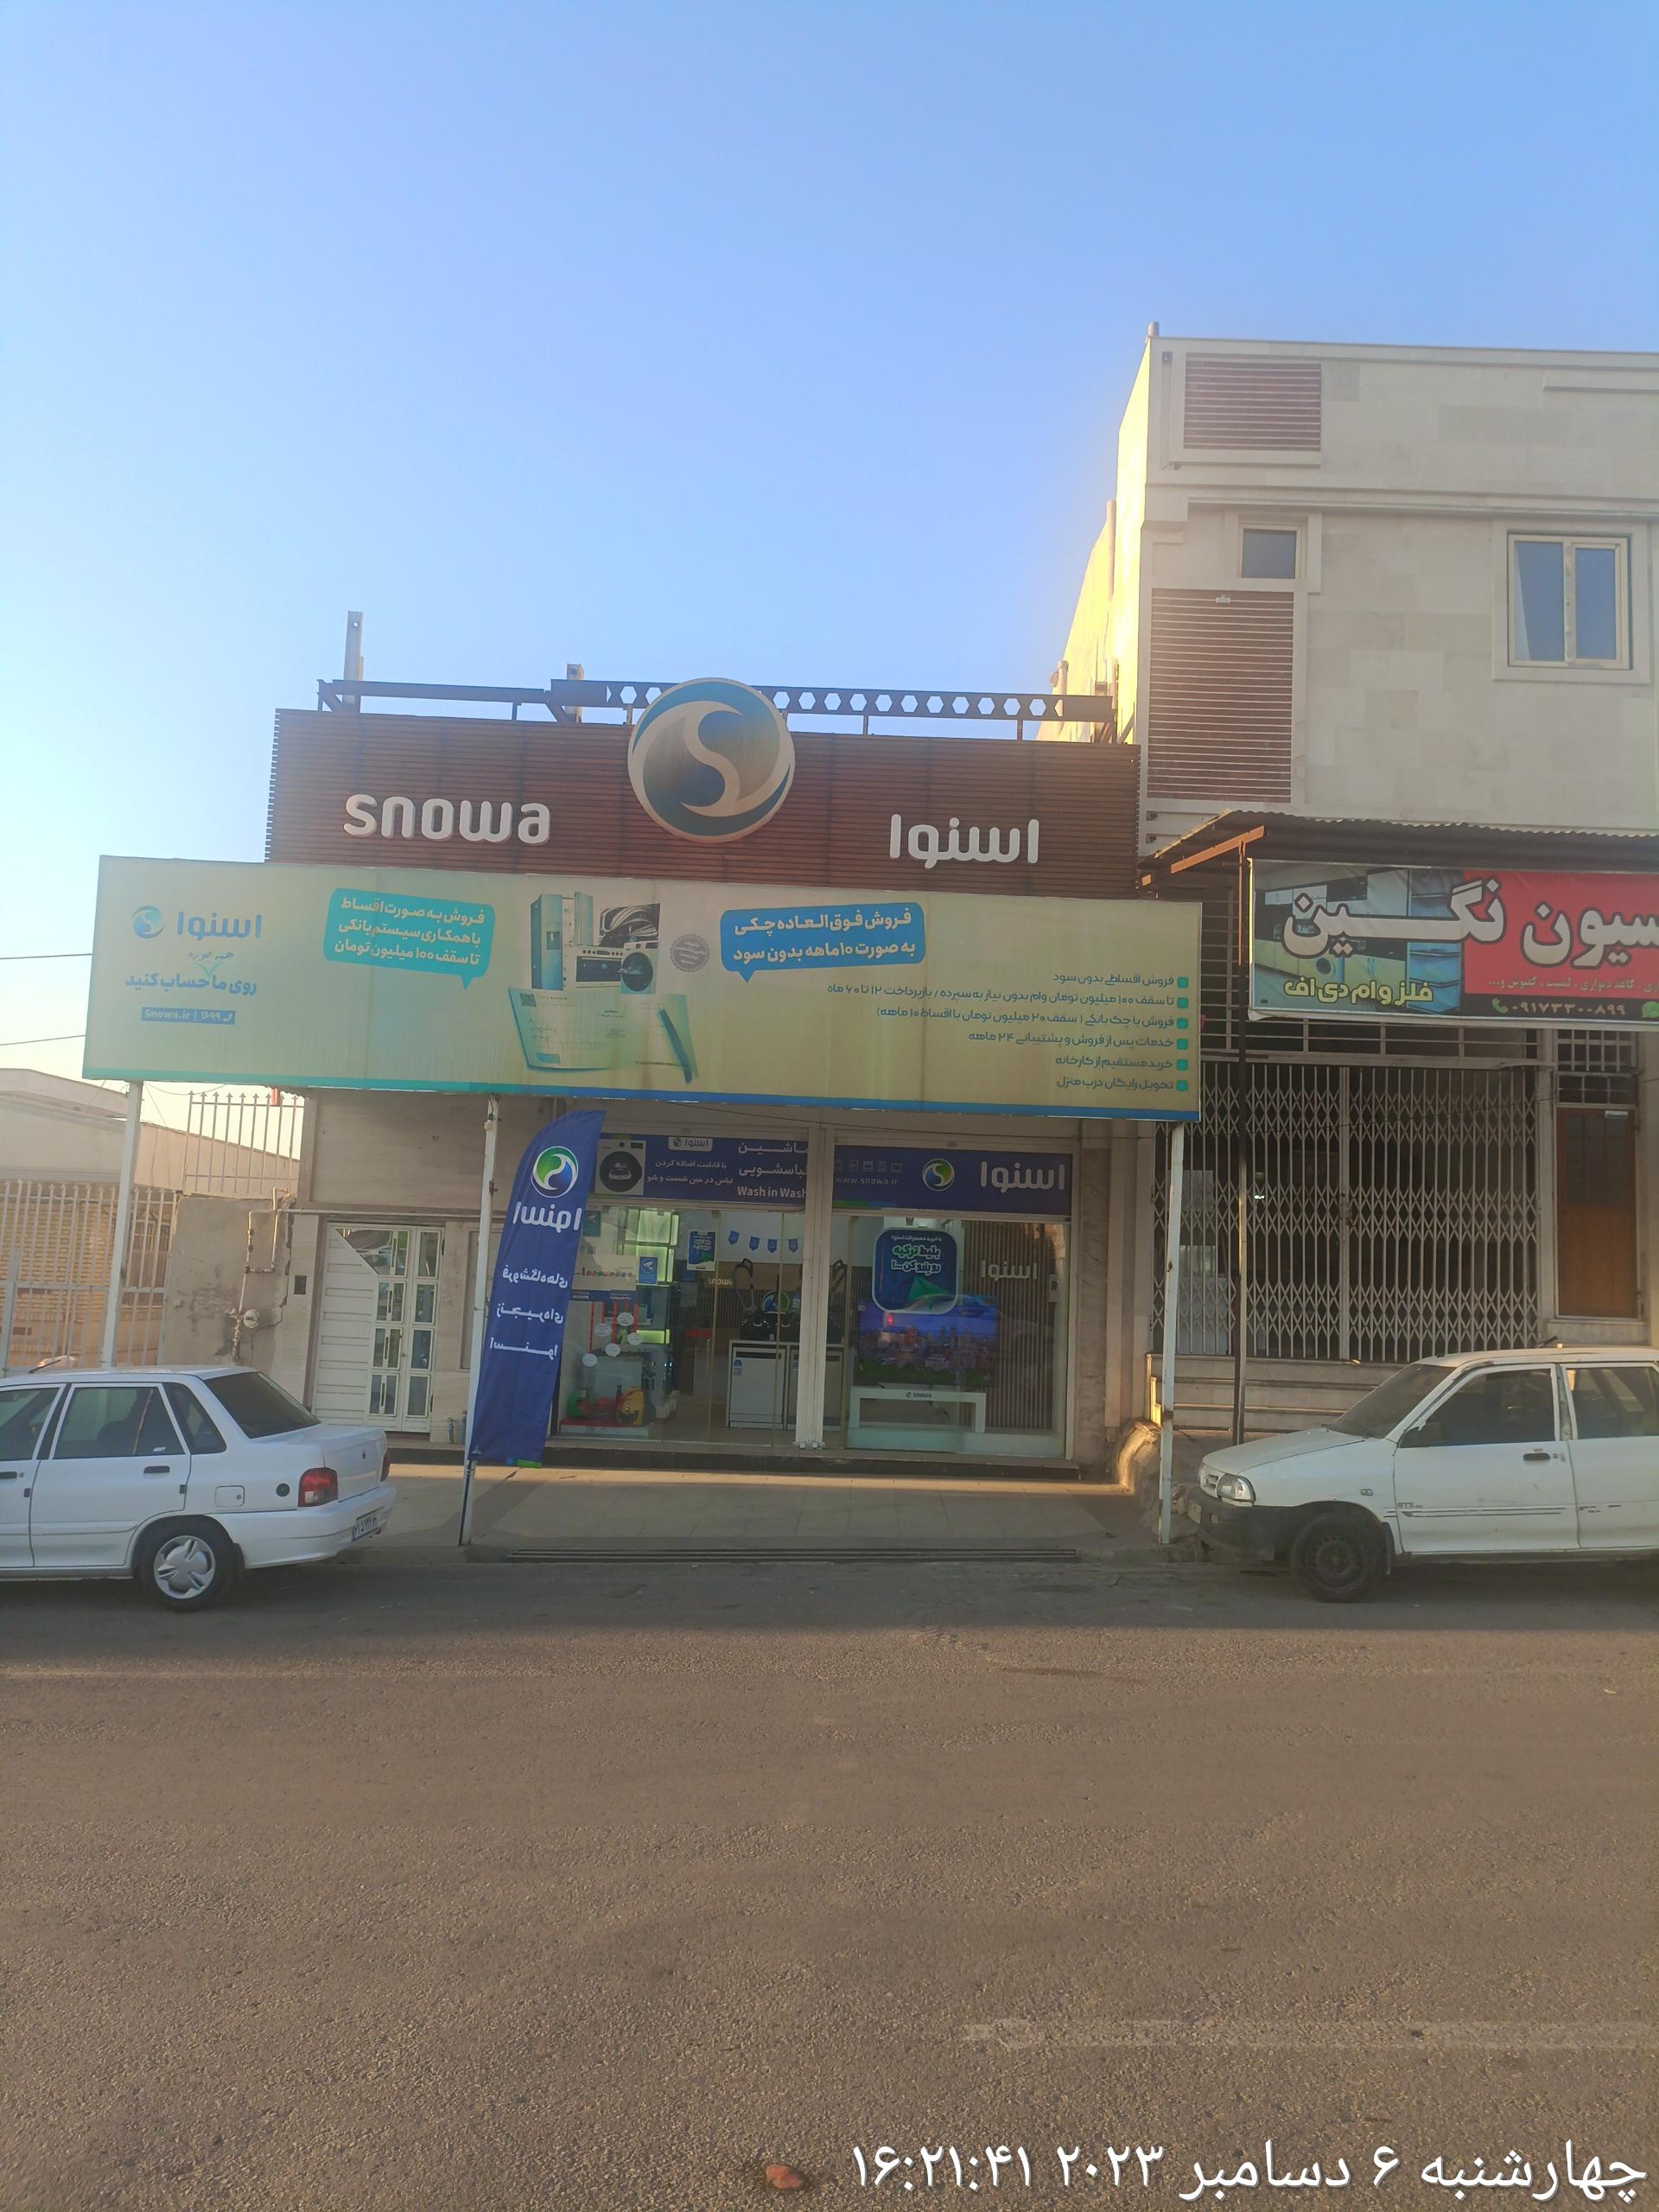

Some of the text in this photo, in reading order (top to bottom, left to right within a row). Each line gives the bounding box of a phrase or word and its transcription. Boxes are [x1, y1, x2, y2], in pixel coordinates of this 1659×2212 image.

[343, 791, 551, 844] snowa
[889, 814, 1039, 868] اسنوا
[340, 896, 486, 927] فروش به صورت اقساط
[1282, 878, 1506, 957] نگین
[176, 911, 263, 940] اسنوا
[734, 907, 912, 937] فروش فوق العاده چکی
[338, 918, 481, 949] با همکاری سیستم بانکی
[334, 938, 480, 965] تا سقف ۱۰۰ میلیون تومان
[767, 946, 803, 963] بدون
[855, 942, 899, 959] صورت
[900, 941, 916, 957] به
[733, 949, 765, 964] سود
[124, 972, 257, 995] روی ما حساب کنید
[1052, 973, 1174, 988] فروش اقساطی بدون سود
[826, 983, 844, 993] ماه
[861, 983, 869, 994] تا
[871, 985, 882, 995] ۱۲
[883, 986, 932, 1002] بازپرداخت
[972, 990, 983, 1000] به
[984, 988, 1001, 1002] نیاز
[1283, 975, 1434, 1007] فلز و ام دی اف
[940, 989, 971, 1003] سپرده
[1003, 990, 1029, 1002] بدون
[1030, 991, 1047, 1003] وام
[1049, 992, 1078, 1005] تومان
[1080, 993, 1116, 1007] میلیون
[1118, 995, 1134, 1004] ۱۰۰
[1135, 995, 1166, 1006] سقف
[1166, 996, 1174, 1006] تا
[920, 1007, 952, 1019] اقساط
[953, 1009, 961, 1020] با
[962, 1010, 991, 1022] تومان
[994, 1011, 1030, 1024] میلیون
[1032, 1012, 1046, 1021] ۲۰
[1085, 1014, 1109, 1027] بانکی
[1109, 1015, 1130, 1029] چک
[1131, 1015, 1141, 1026] با
[1141, 1016, 1174, 1030] فروش
[968, 1031, 996, 1041] ماهه
[1015, 1033, 1063, 1049] پشتیبانی
[1064, 1037, 1071, 1046] و
[1072, 1034, 1104, 1047] فروش
[1106, 1035, 1114, 1046] از
[1135, 1037, 1173, 1047] خدمات
[1113, 1038, 1134, 1051] پس
[1055, 1055, 1173, 1071] خرید مستقیم از کارخانه
[1057, 1076, 1173, 1091] تحویل رایگان درب منزل
[738, 1141, 808, 1155] اشین
[738, 1162, 807, 1179] باسشویی
[980, 1160, 1065, 1193] اسنوا
[737, 1185, 766, 1197] Wash
[768, 1186, 778, 1197] in
[981, 1260, 1038, 1282] اسنوا
